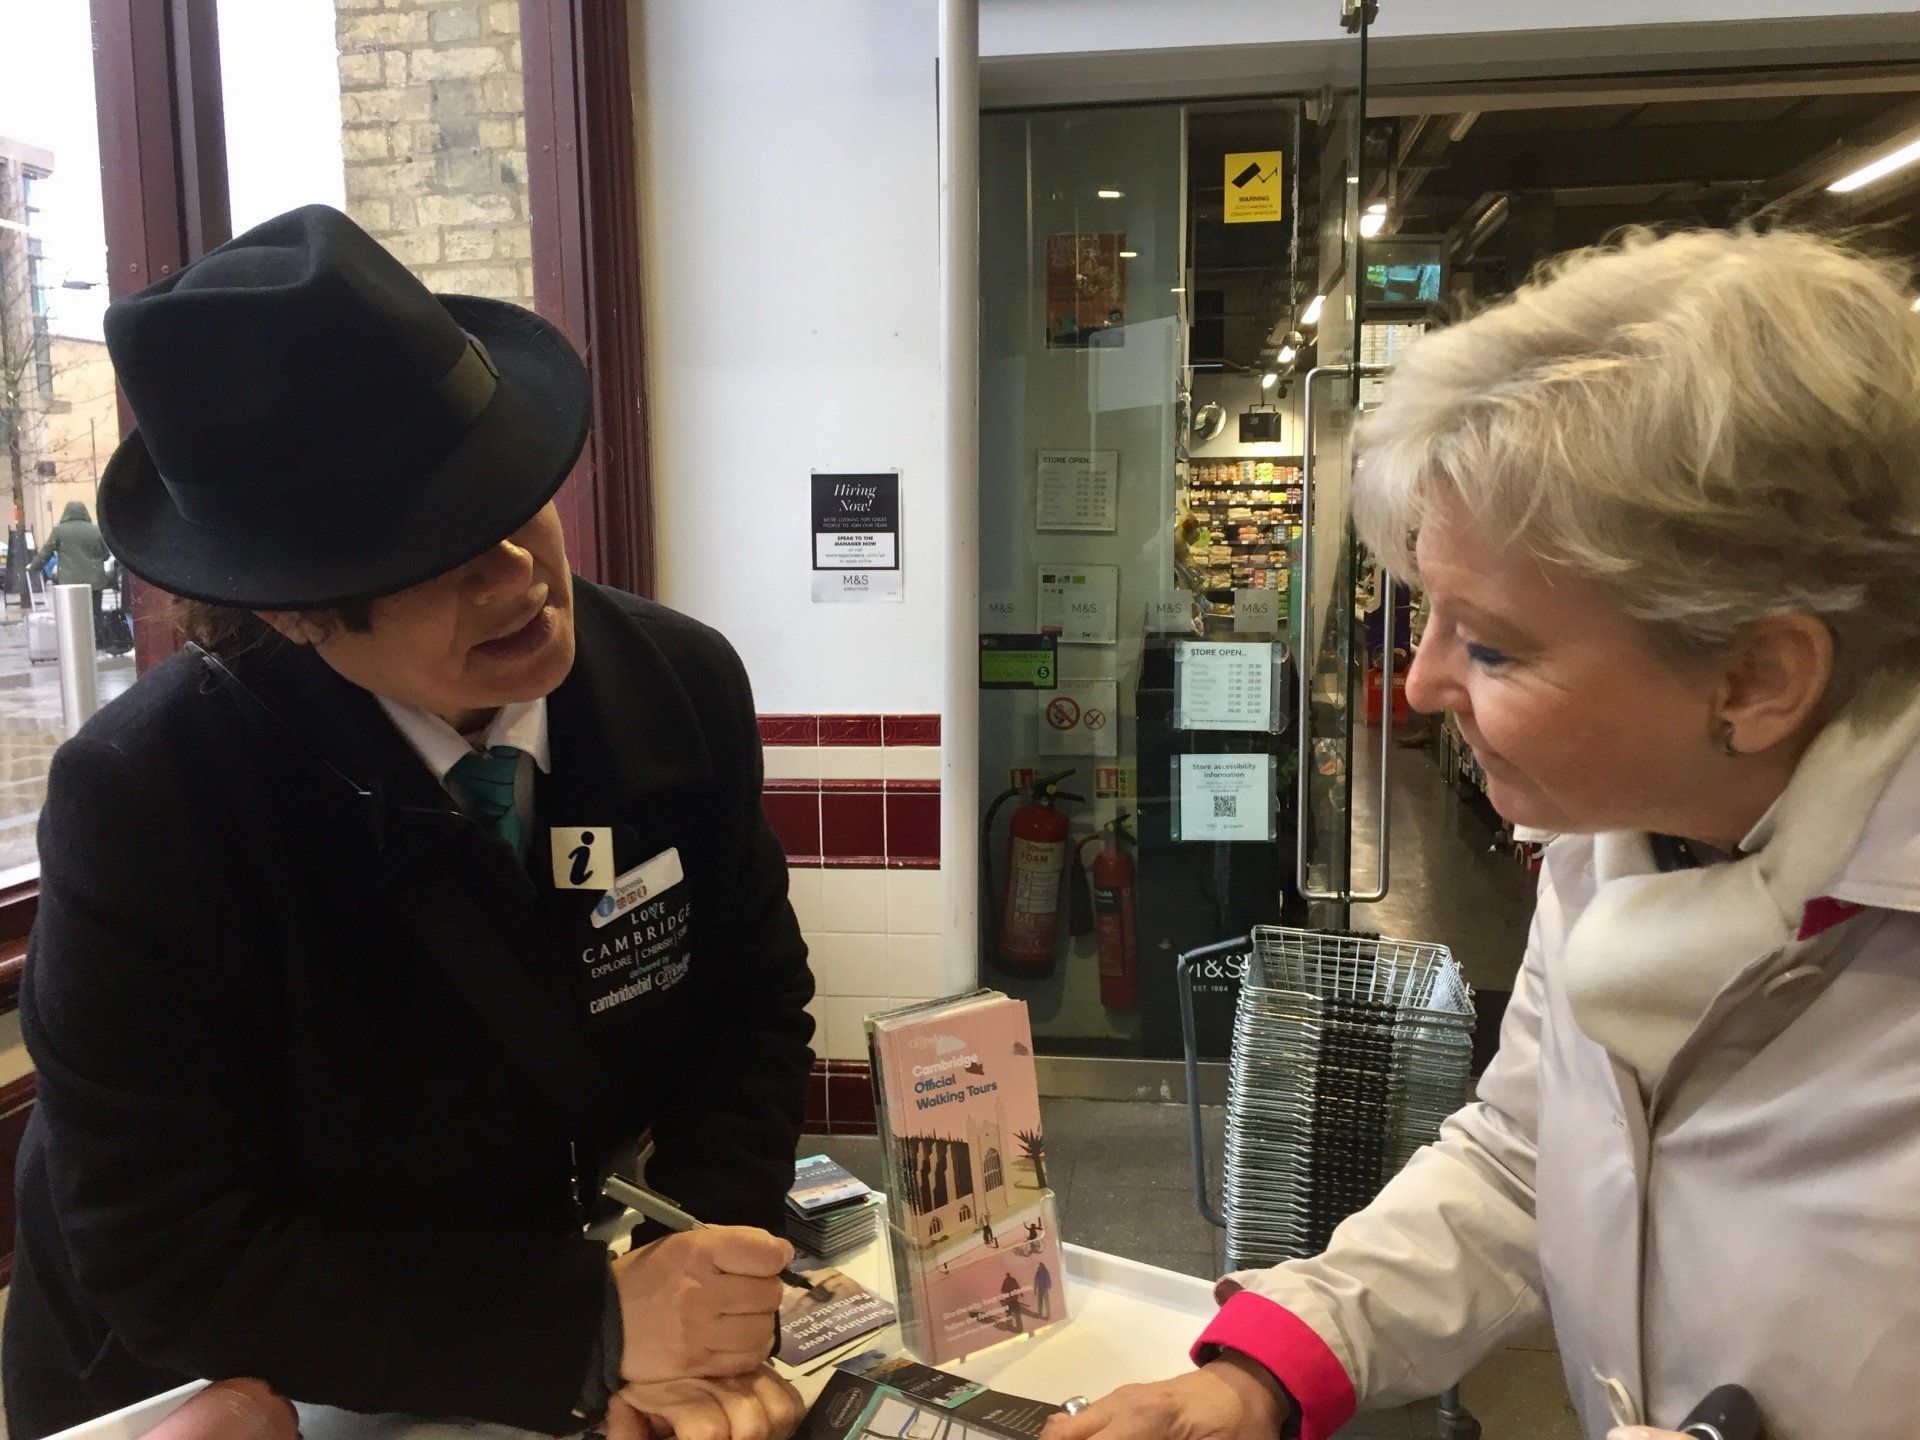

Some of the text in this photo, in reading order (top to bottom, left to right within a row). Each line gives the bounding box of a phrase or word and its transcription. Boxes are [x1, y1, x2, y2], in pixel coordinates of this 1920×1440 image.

[1043, 457, 1067, 465] STORE
[834, 484, 877, 500] Hiring
[839, 500, 872, 512] Now!
[843, 575, 869, 586] M&S
[988, 603, 1014, 614] M&S
[1072, 603, 1098, 614] M&S
[1156, 603, 1182, 614] M&S
[1242, 603, 1268, 614] M&S
[1020, 852, 1048, 864] FOAM
[630, 901, 666, 926] LOVE
[582, 902, 691, 963] CAMBRIDGE
[591, 954, 633, 979] EXPLORE
[912, 1054, 978, 1078] Cambridge
[914, 1074, 957, 1094] Official
[916, 1082, 998, 1110] Walking Tours
[780, 1291, 871, 1334] Fantastic food
[794, 1317, 830, 1340] sights
[798, 1307, 895, 1352] Stunning views
